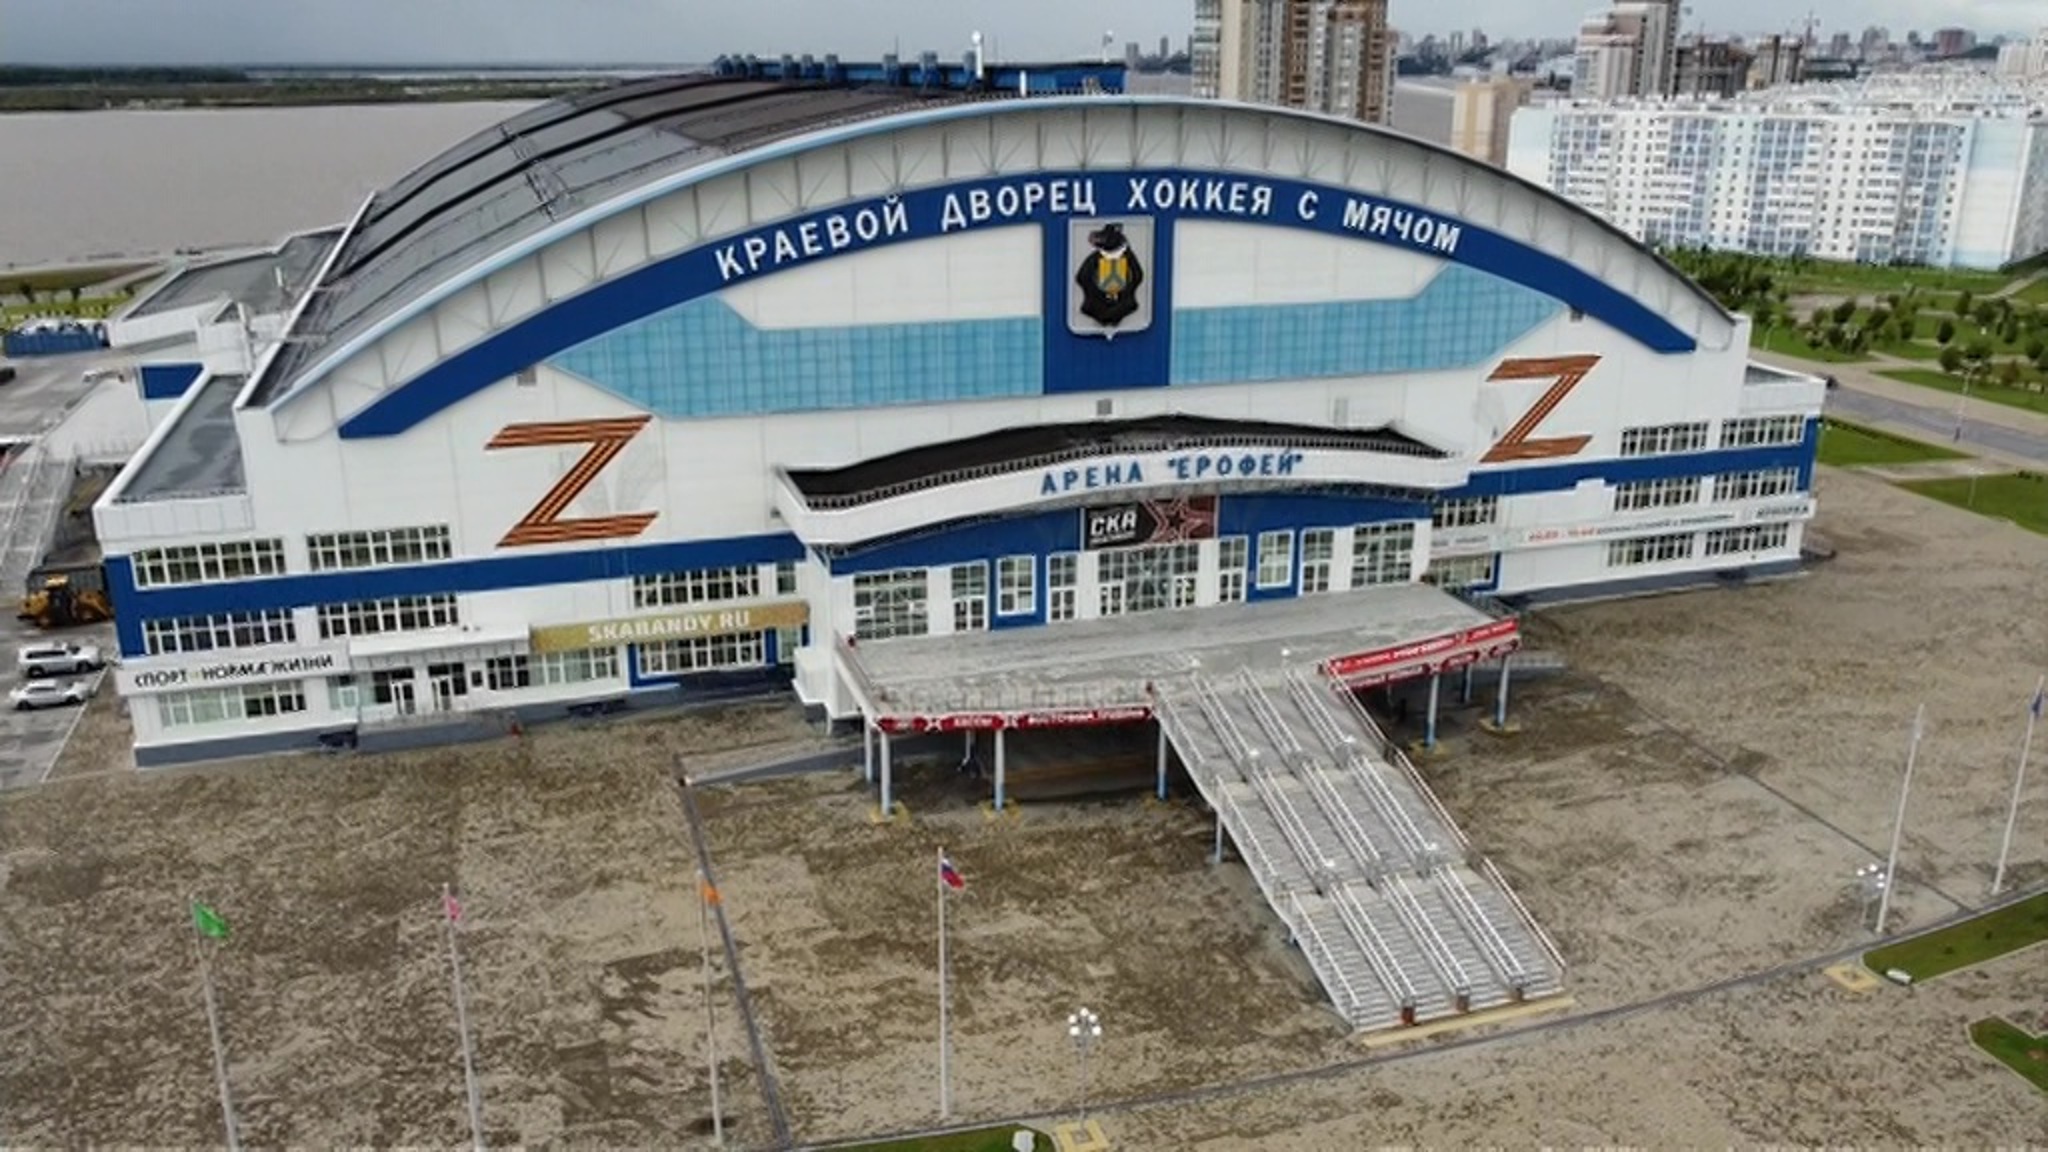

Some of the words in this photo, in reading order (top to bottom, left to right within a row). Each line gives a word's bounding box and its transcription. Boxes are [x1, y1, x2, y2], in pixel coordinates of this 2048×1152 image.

[715, 195, 908, 281] КРАЕВОЙ
[941, 178, 1096, 232] ДВОРЕЦ
[1127, 177, 1272, 215] ХОККЕЯ
[1298, 190, 1319, 221] С
[1343, 199, 1461, 254] МЯЧОМ
[1479, 354, 1603, 463] Z
[484, 414, 660, 549] Z
[1040, 461, 1144, 495] АРЕНА
[1090, 509, 1137, 536] СКА
